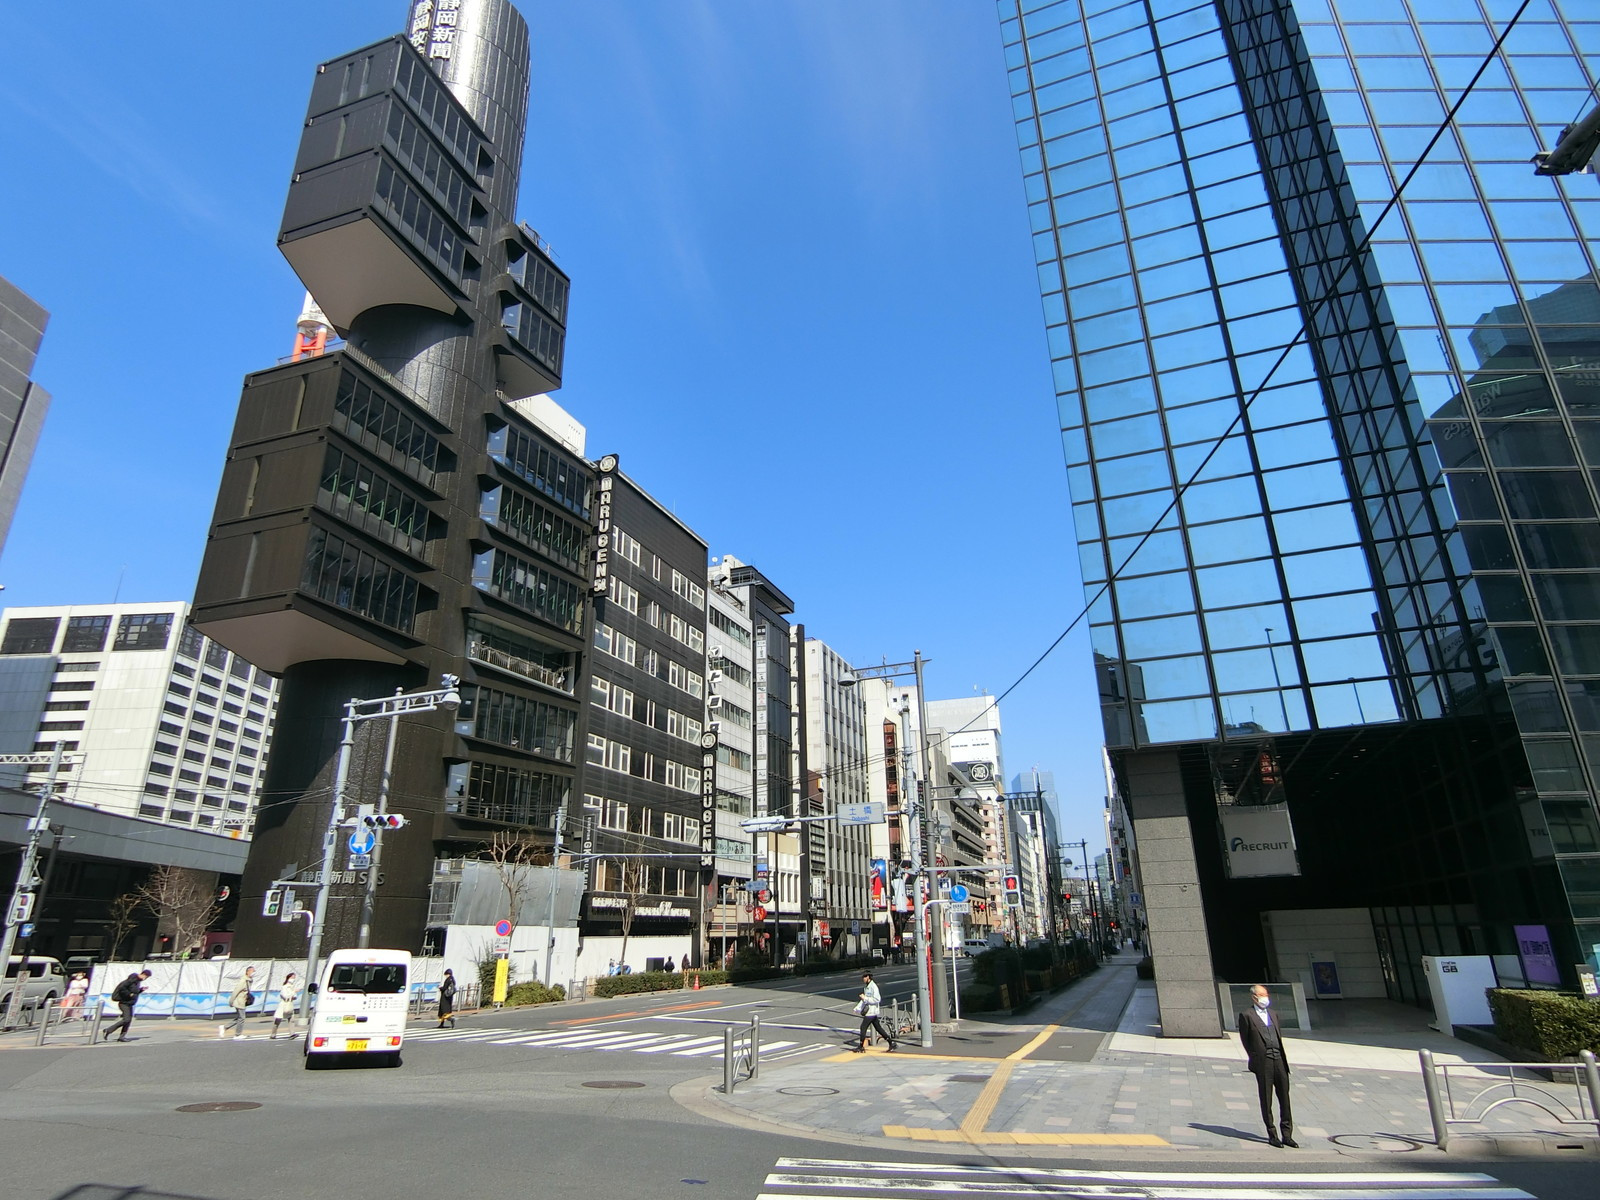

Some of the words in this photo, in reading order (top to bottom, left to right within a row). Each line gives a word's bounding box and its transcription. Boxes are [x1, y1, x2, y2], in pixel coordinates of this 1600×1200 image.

[597, 477, 612, 577] MARUGEN
[702, 754, 714, 852] MARUGEN
[849, 806, 872, 816] 土橋
[1241, 841, 1289, 852] RECRUIT
[359, 871, 385, 885] SS
